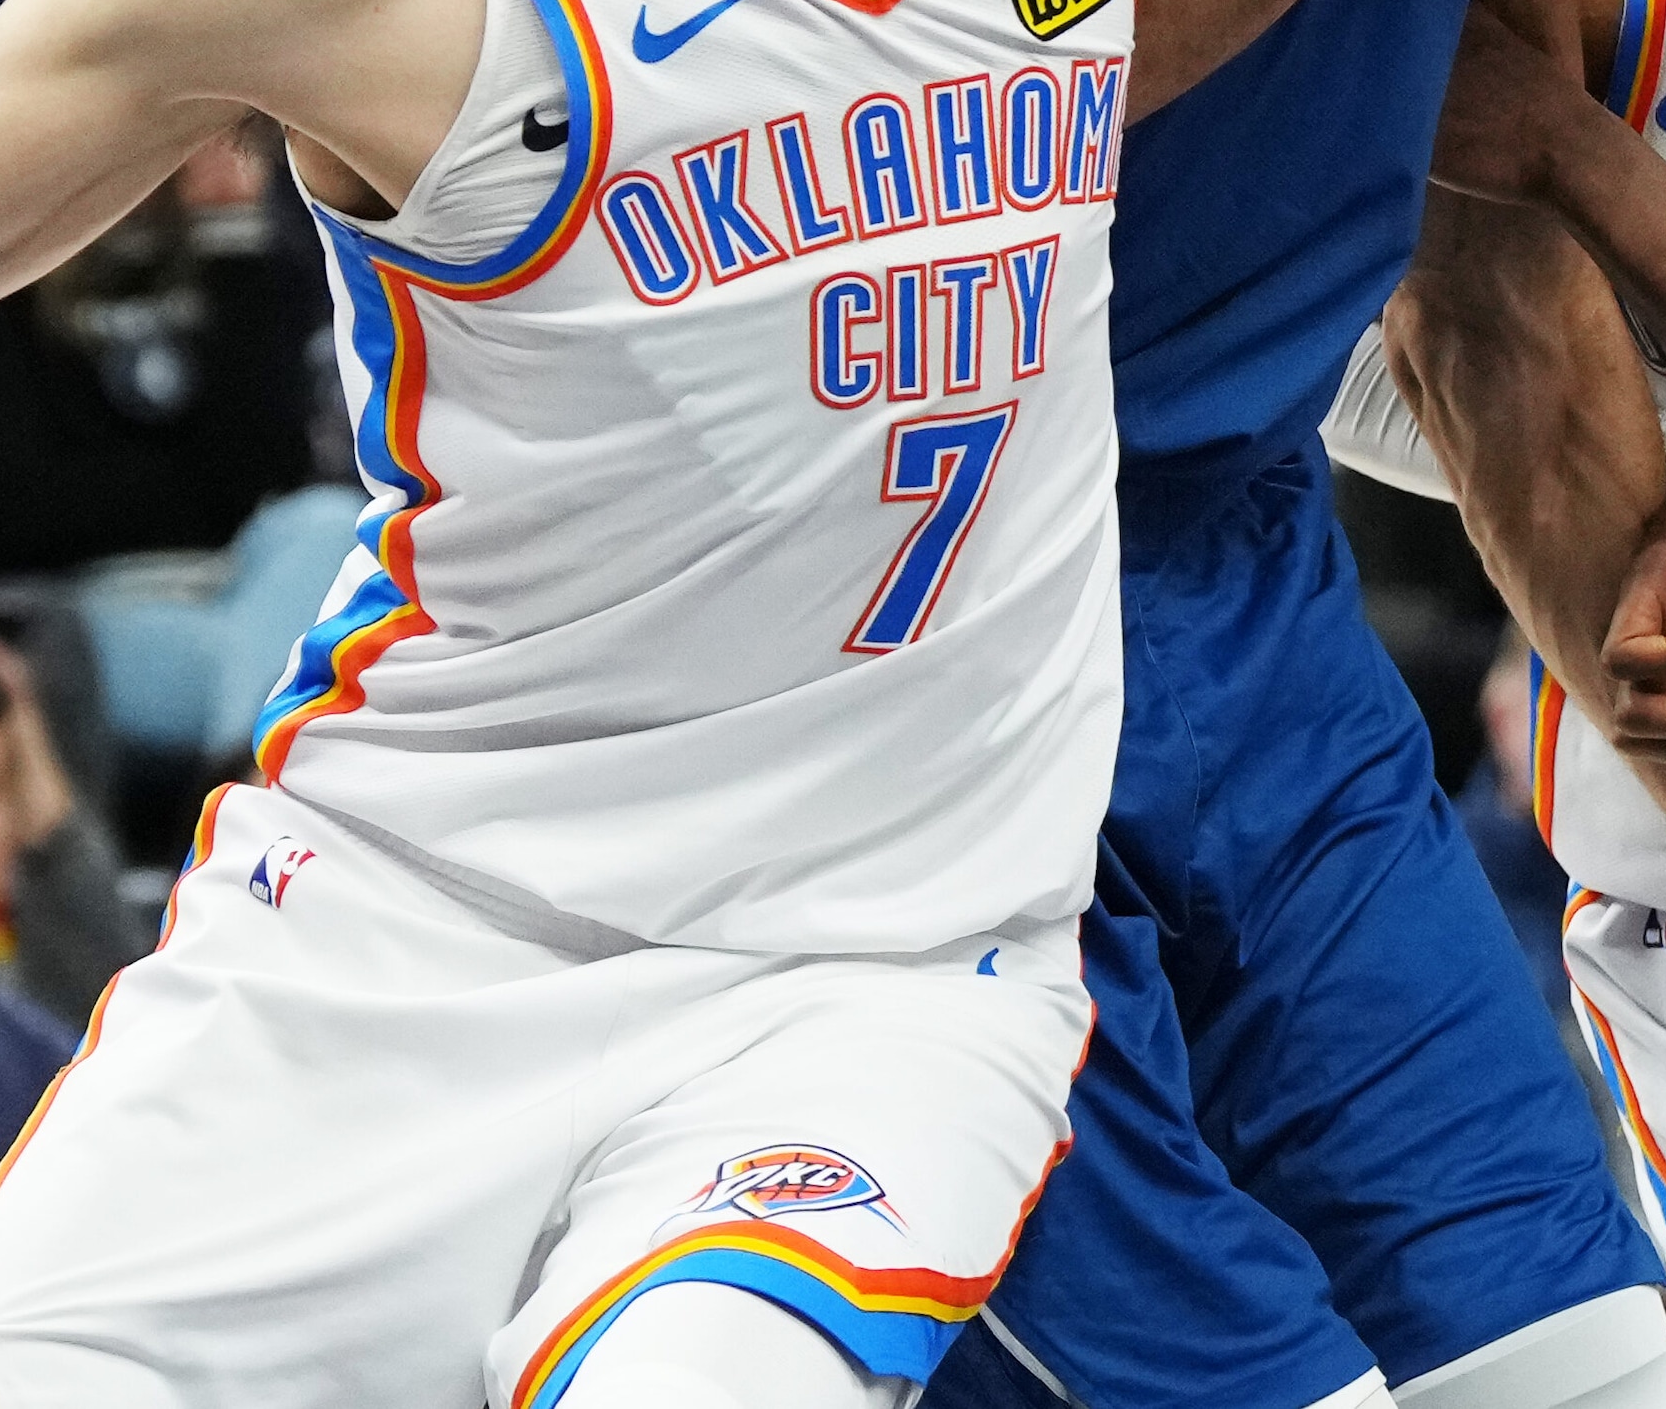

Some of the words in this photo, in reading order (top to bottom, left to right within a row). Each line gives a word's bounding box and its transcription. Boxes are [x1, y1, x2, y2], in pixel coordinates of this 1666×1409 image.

[595, 57, 1125, 306] OKLAHOM
[810, 234, 1060, 410] CITY
[840, 398, 1019, 655] 7
